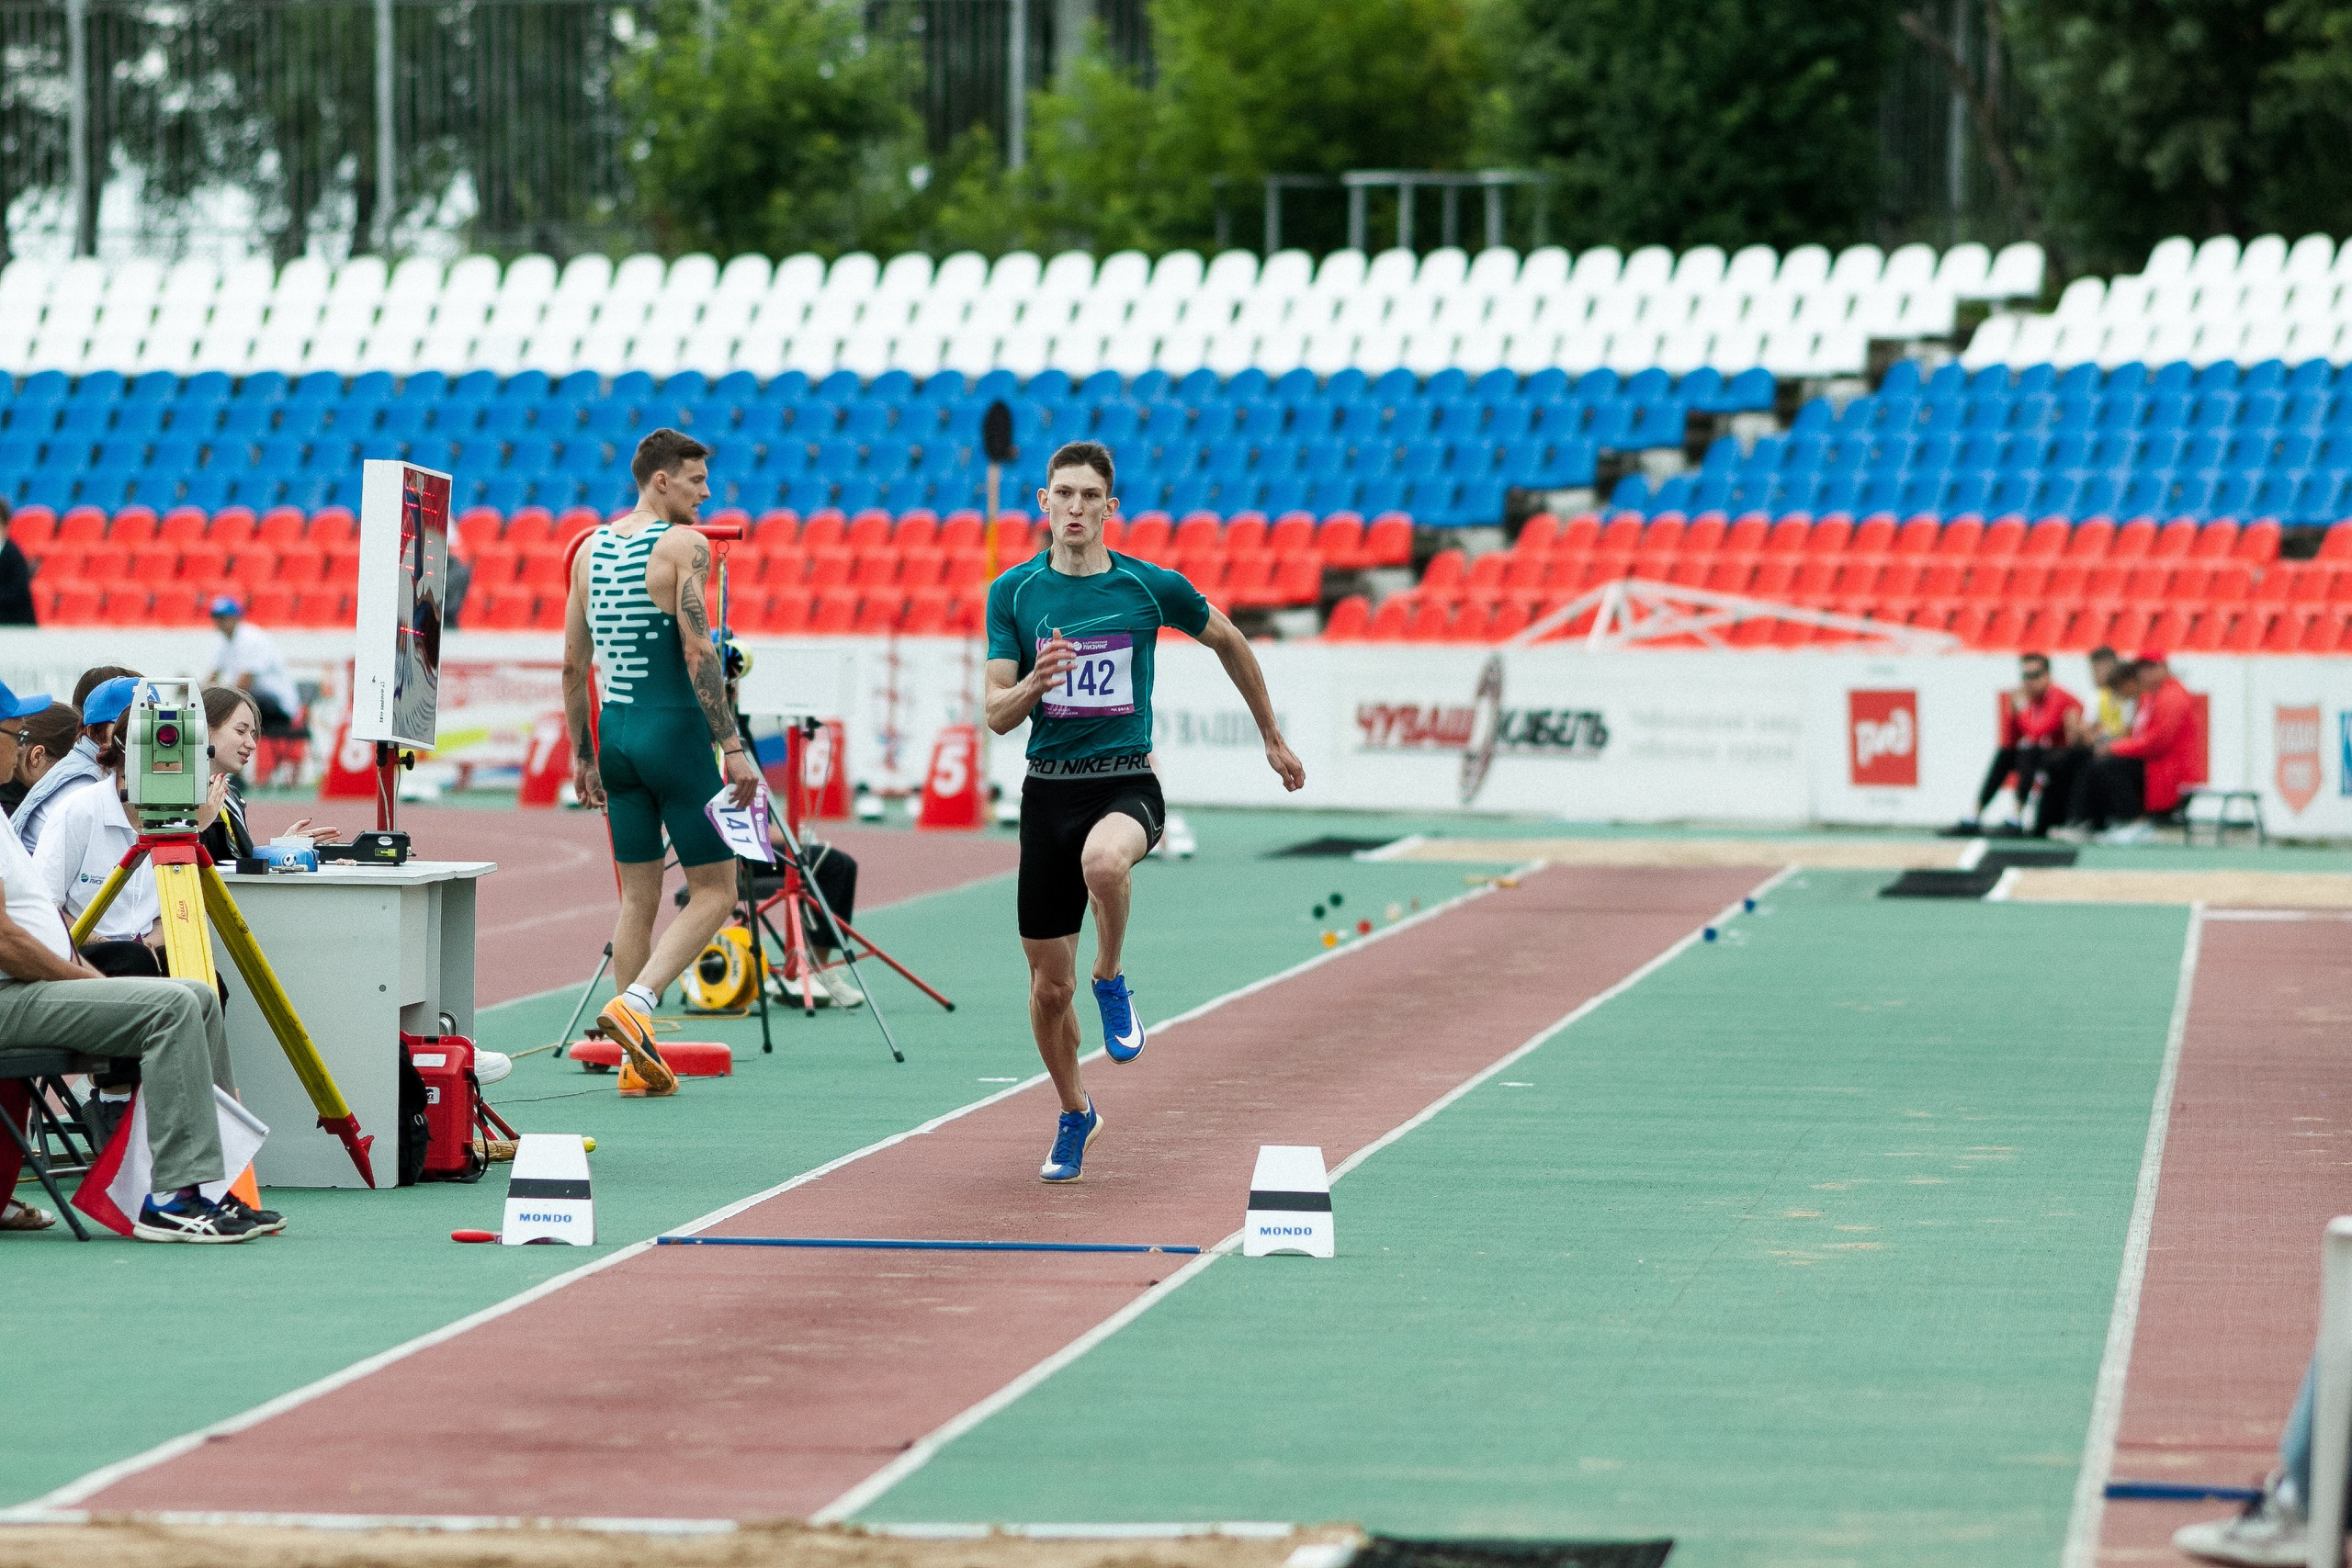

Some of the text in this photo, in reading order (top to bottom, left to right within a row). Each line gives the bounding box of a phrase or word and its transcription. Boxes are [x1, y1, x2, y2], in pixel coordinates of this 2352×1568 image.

[1066, 660, 1115, 697] 142
[933, 744, 969, 798] 5
[1060, 755, 1114, 774] NIKE
[719, 807, 753, 844] 141
[175, 899, 189, 924] Leica
[519, 1213, 572, 1223] MONDO
[1260, 1226, 1313, 1235] MONDO
